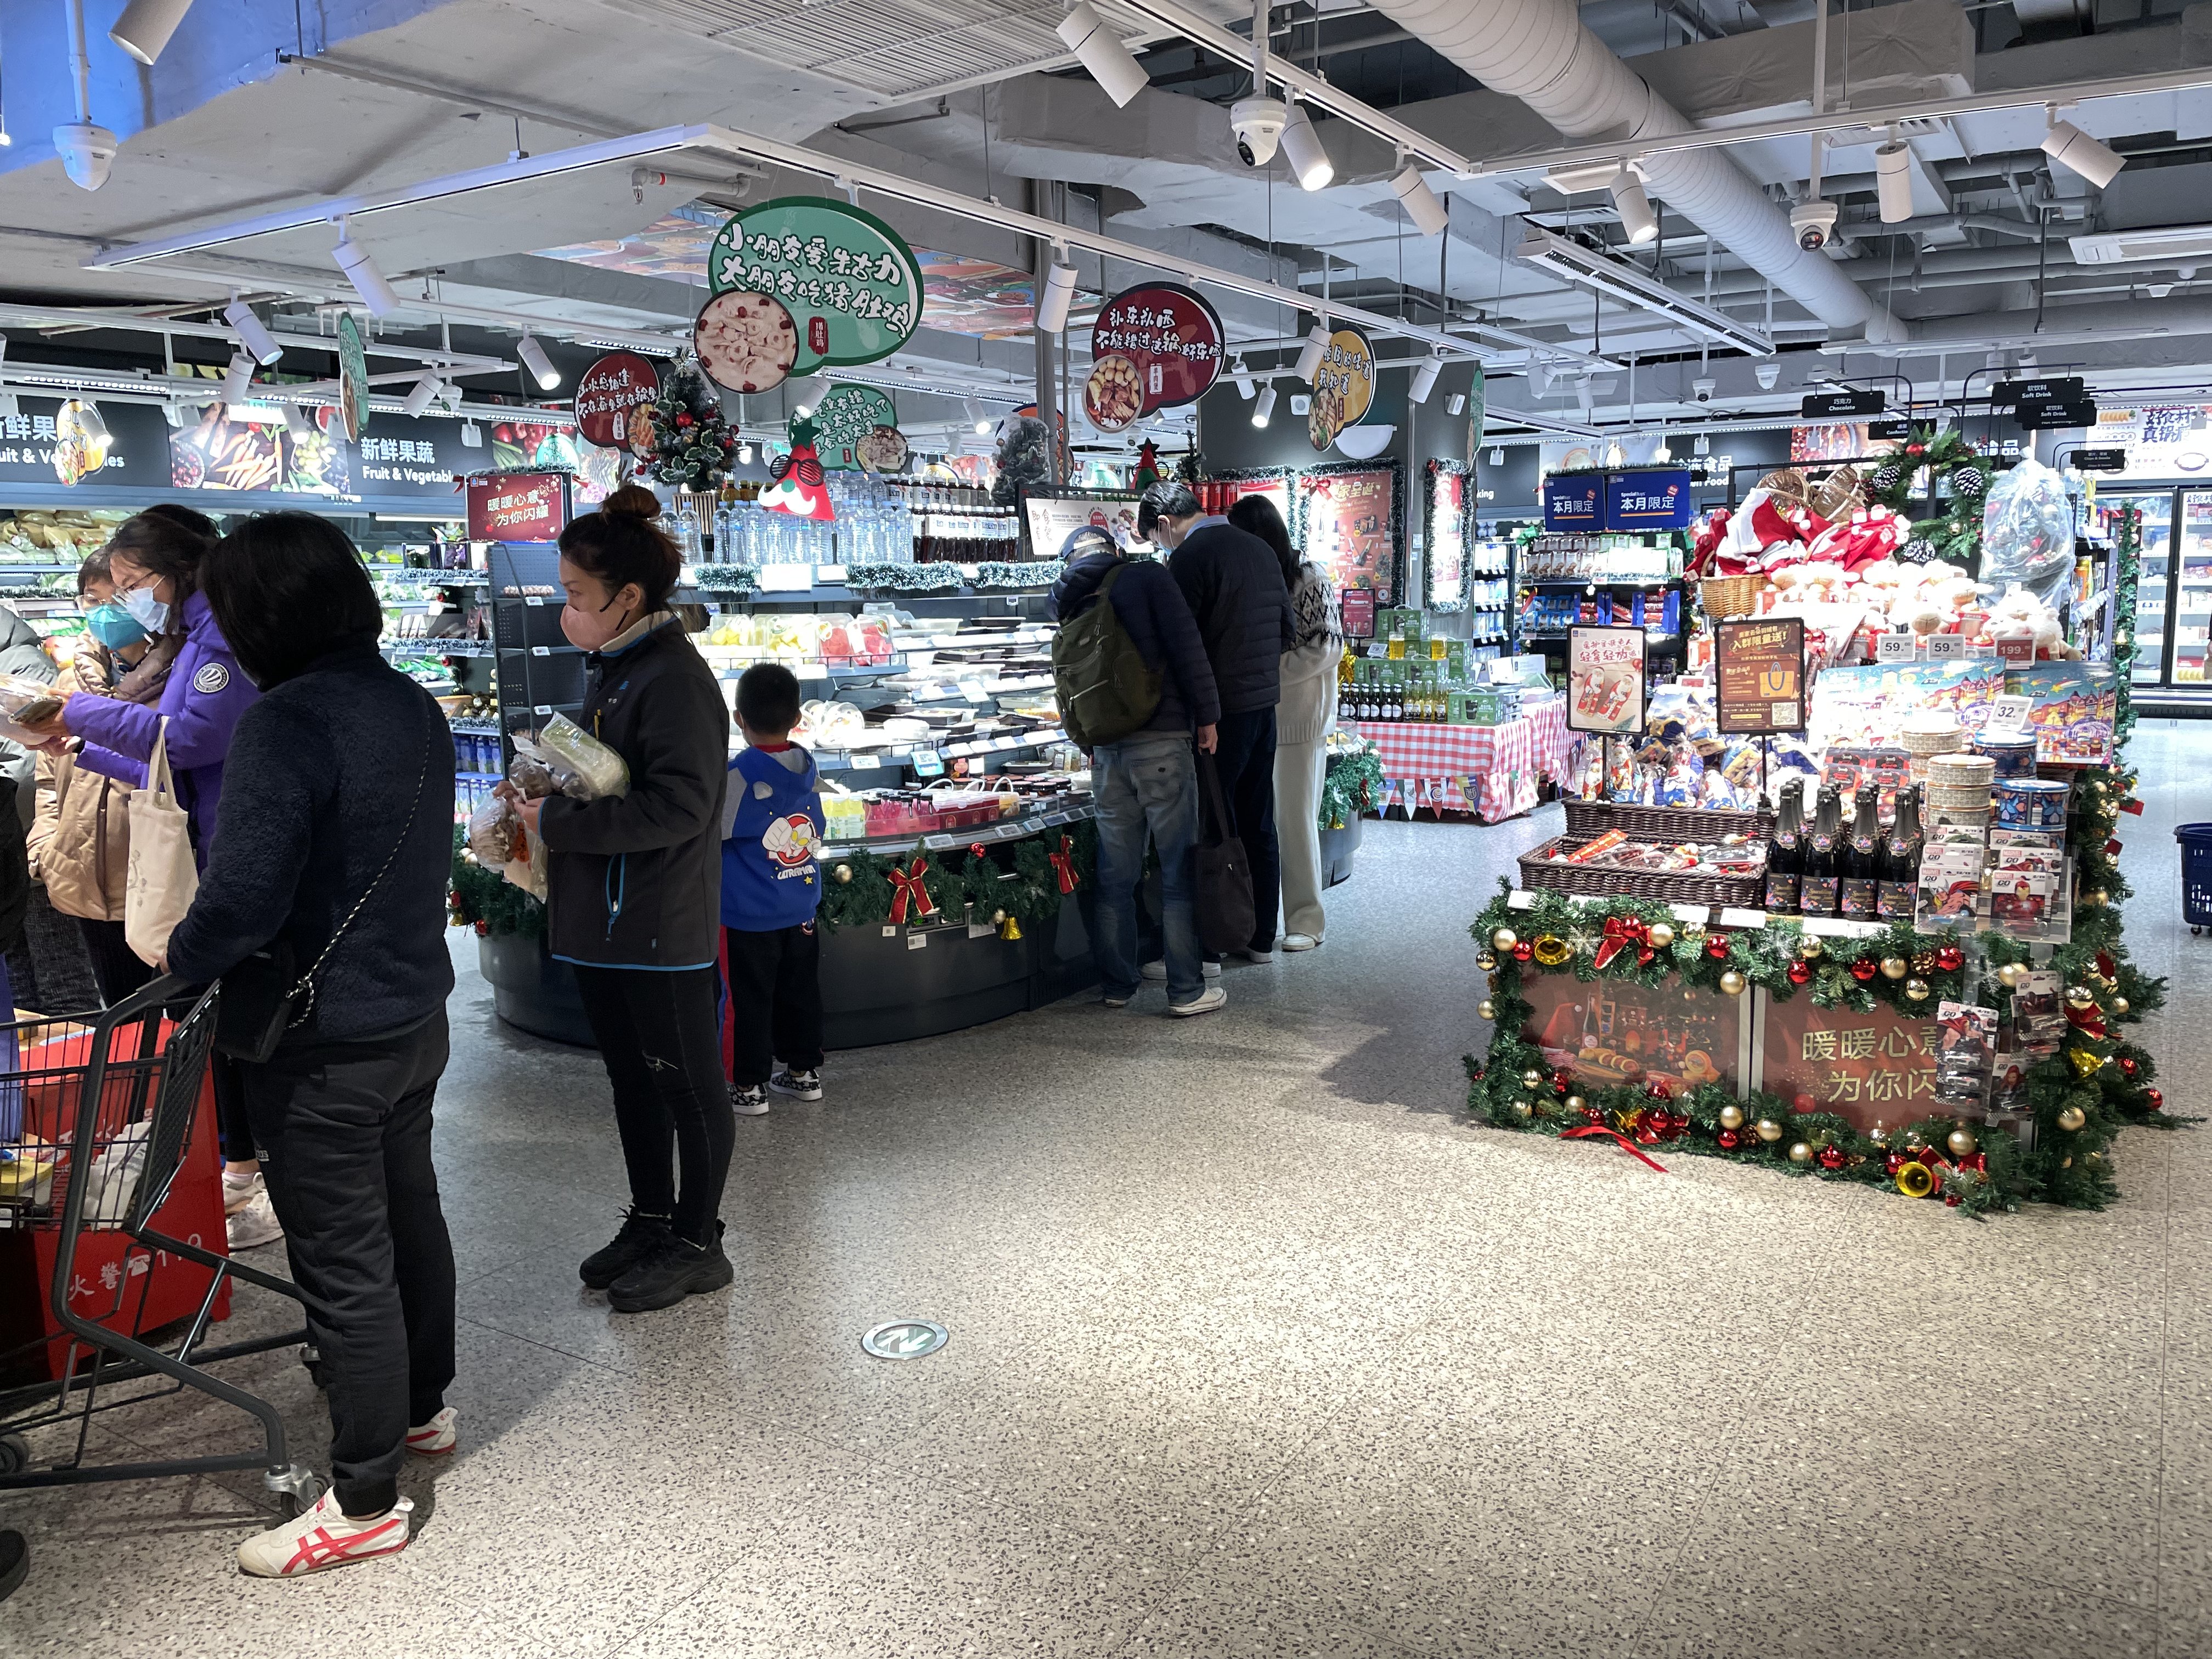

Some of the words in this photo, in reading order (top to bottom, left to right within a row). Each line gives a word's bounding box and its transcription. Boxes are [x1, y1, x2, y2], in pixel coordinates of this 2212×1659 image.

[719, 223, 901, 285] 小朋友爱朱古力
[720, 256, 909, 338] 大朋友吃猪肚鸡
[1110, 306, 1176, 329] 补东补西
[815, 321, 824, 347] 猪肚鸡
[1096, 330, 1222, 361] 不能错过这锅好东西
[0, 413, 57, 442] 鲜果
[22, 448, 36, 464] &
[360, 437, 436, 464] 新鲜果蔬
[363, 465, 391, 480] Fruit
[392, 467, 402, 481] &
[403, 467, 454, 486] Vegetabl
[487, 489, 540, 512] 暖暖心意
[1553, 500, 1594, 514] 本月限定
[1621, 495, 1675, 511] 本月限定
[496, 504, 549, 527] 为你闪耀
[777, 865, 816, 880] ULTRAMAN
[67, 1261, 121, 1301] 火警
